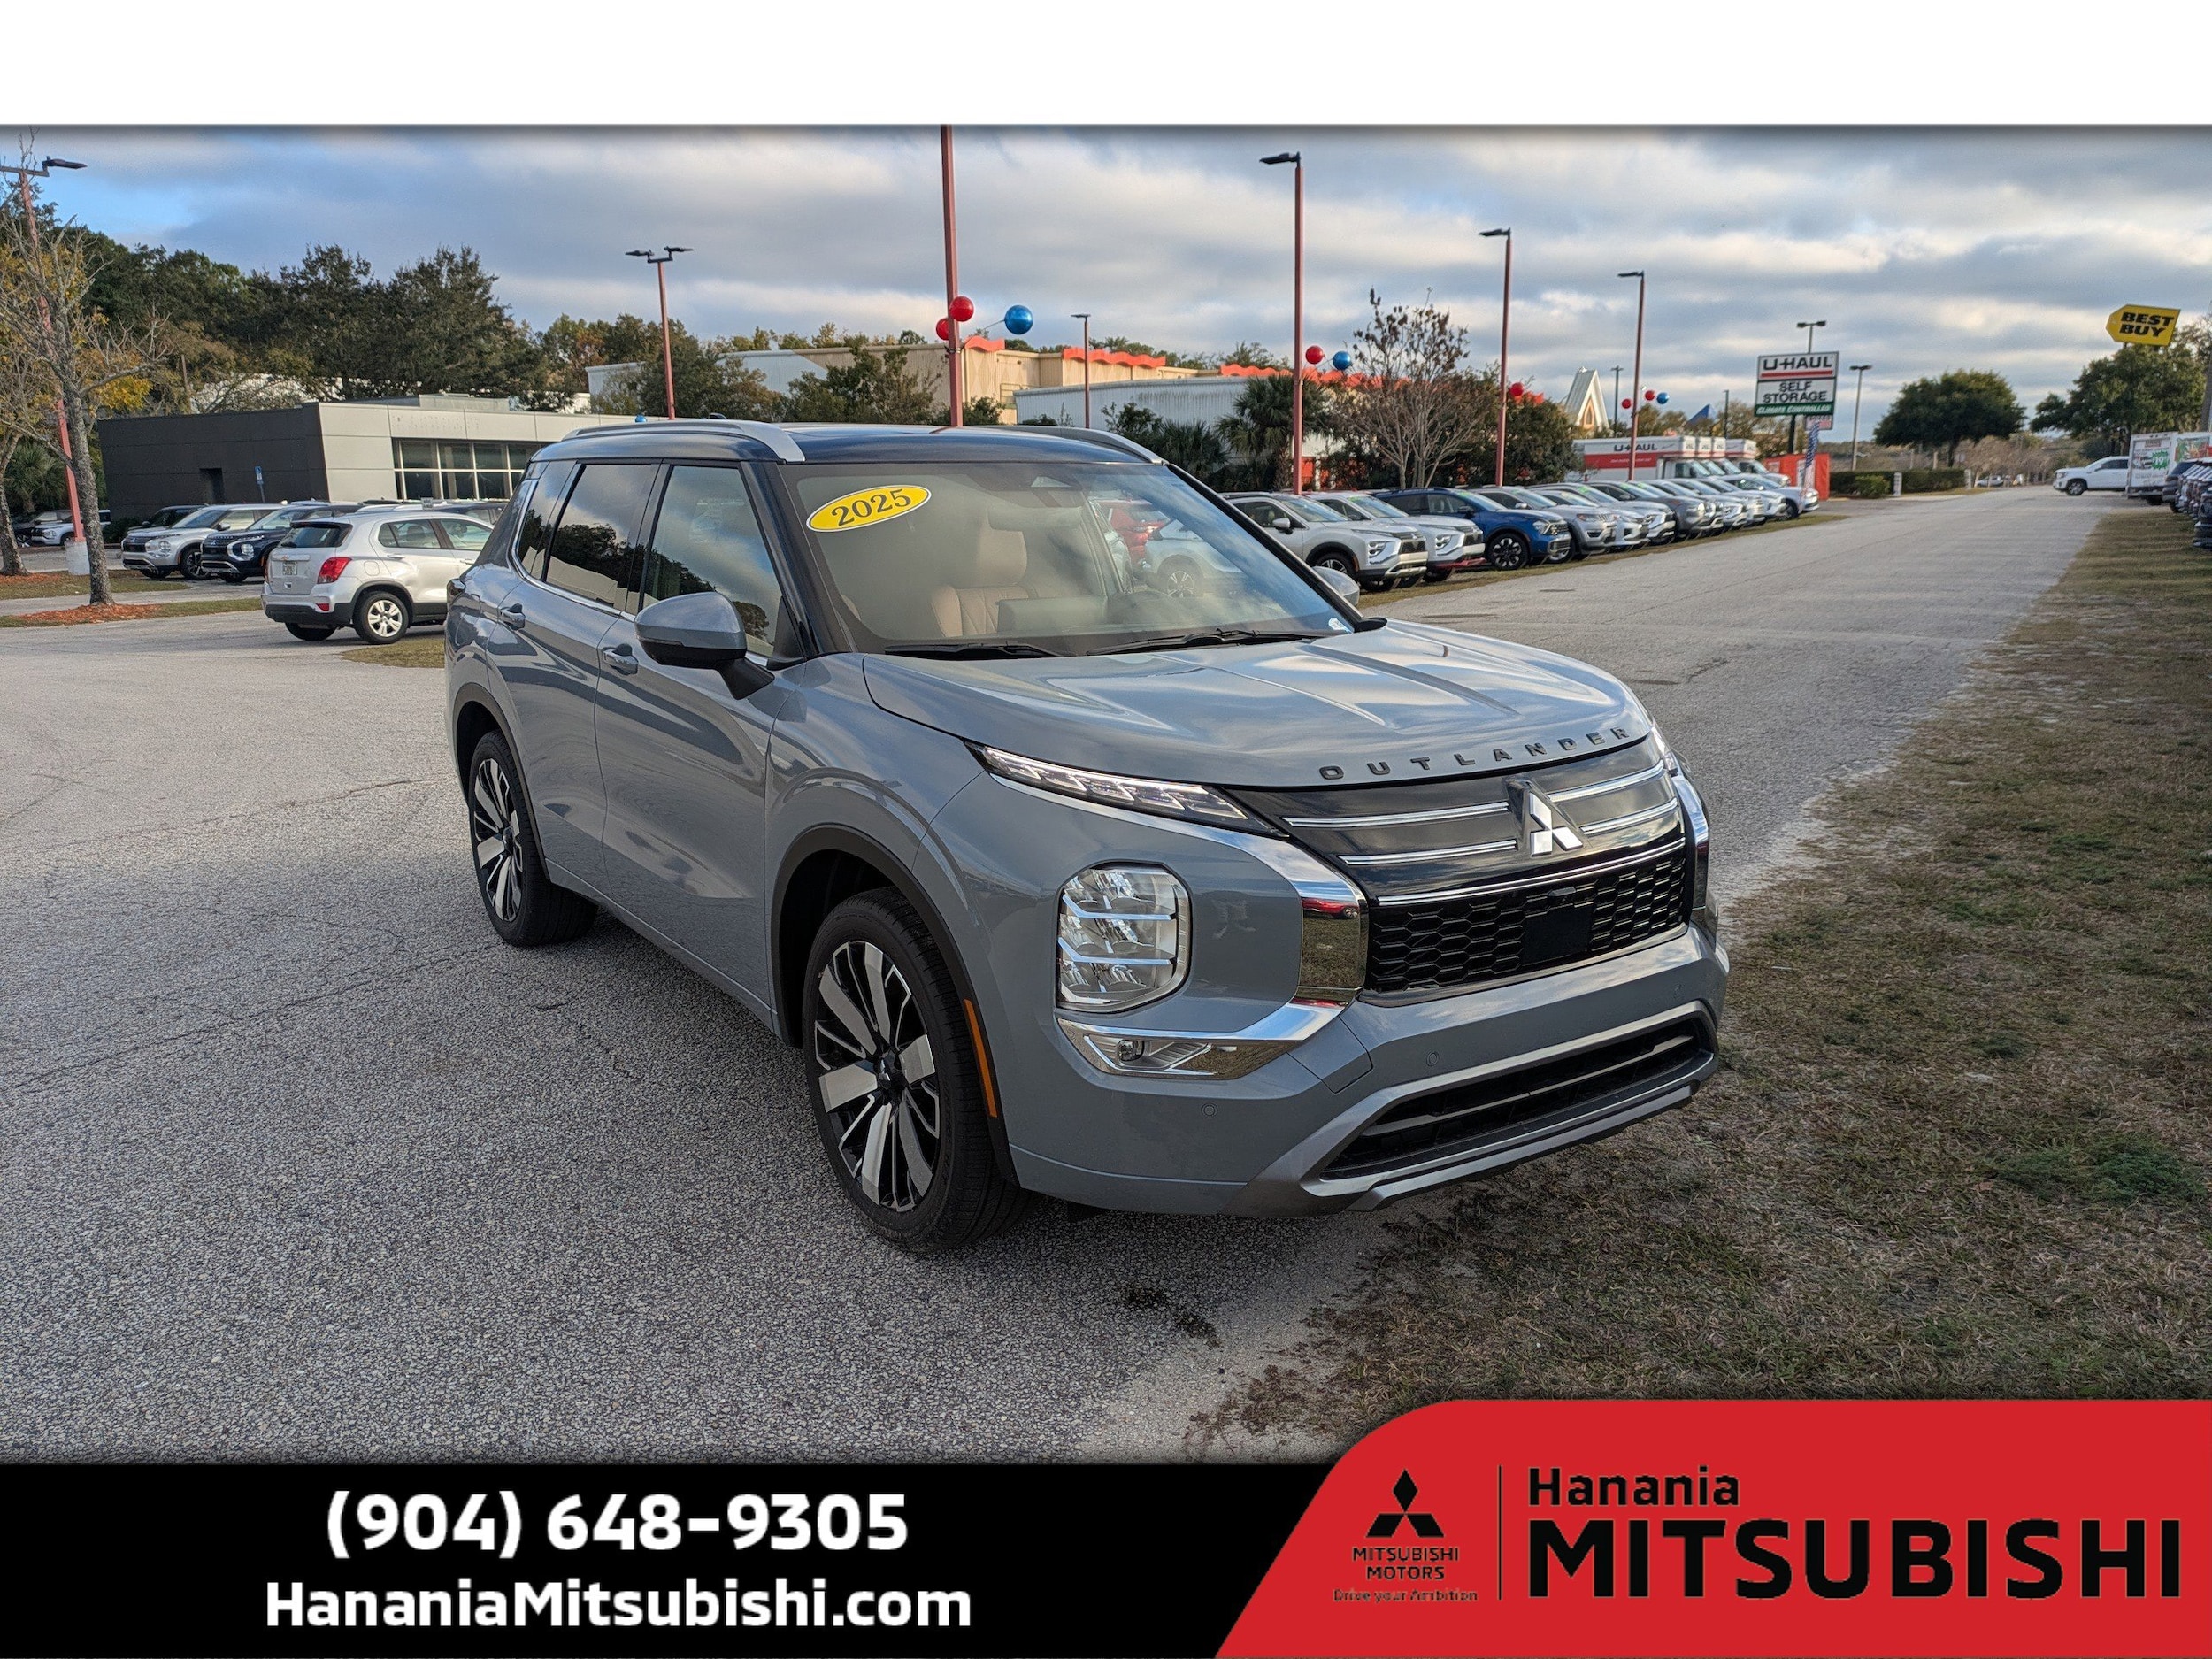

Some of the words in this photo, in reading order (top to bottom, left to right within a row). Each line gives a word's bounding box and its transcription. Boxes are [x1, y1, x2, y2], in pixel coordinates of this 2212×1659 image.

[2121, 312, 2174, 326] BEST
[2119, 324, 2166, 337] BUY
[1778, 381, 1812, 392] SELF
[1763, 391, 1827, 403] STORAGE
[831, 488, 911, 526] 2025
[1319, 727, 1630, 780] OUTLANDER
